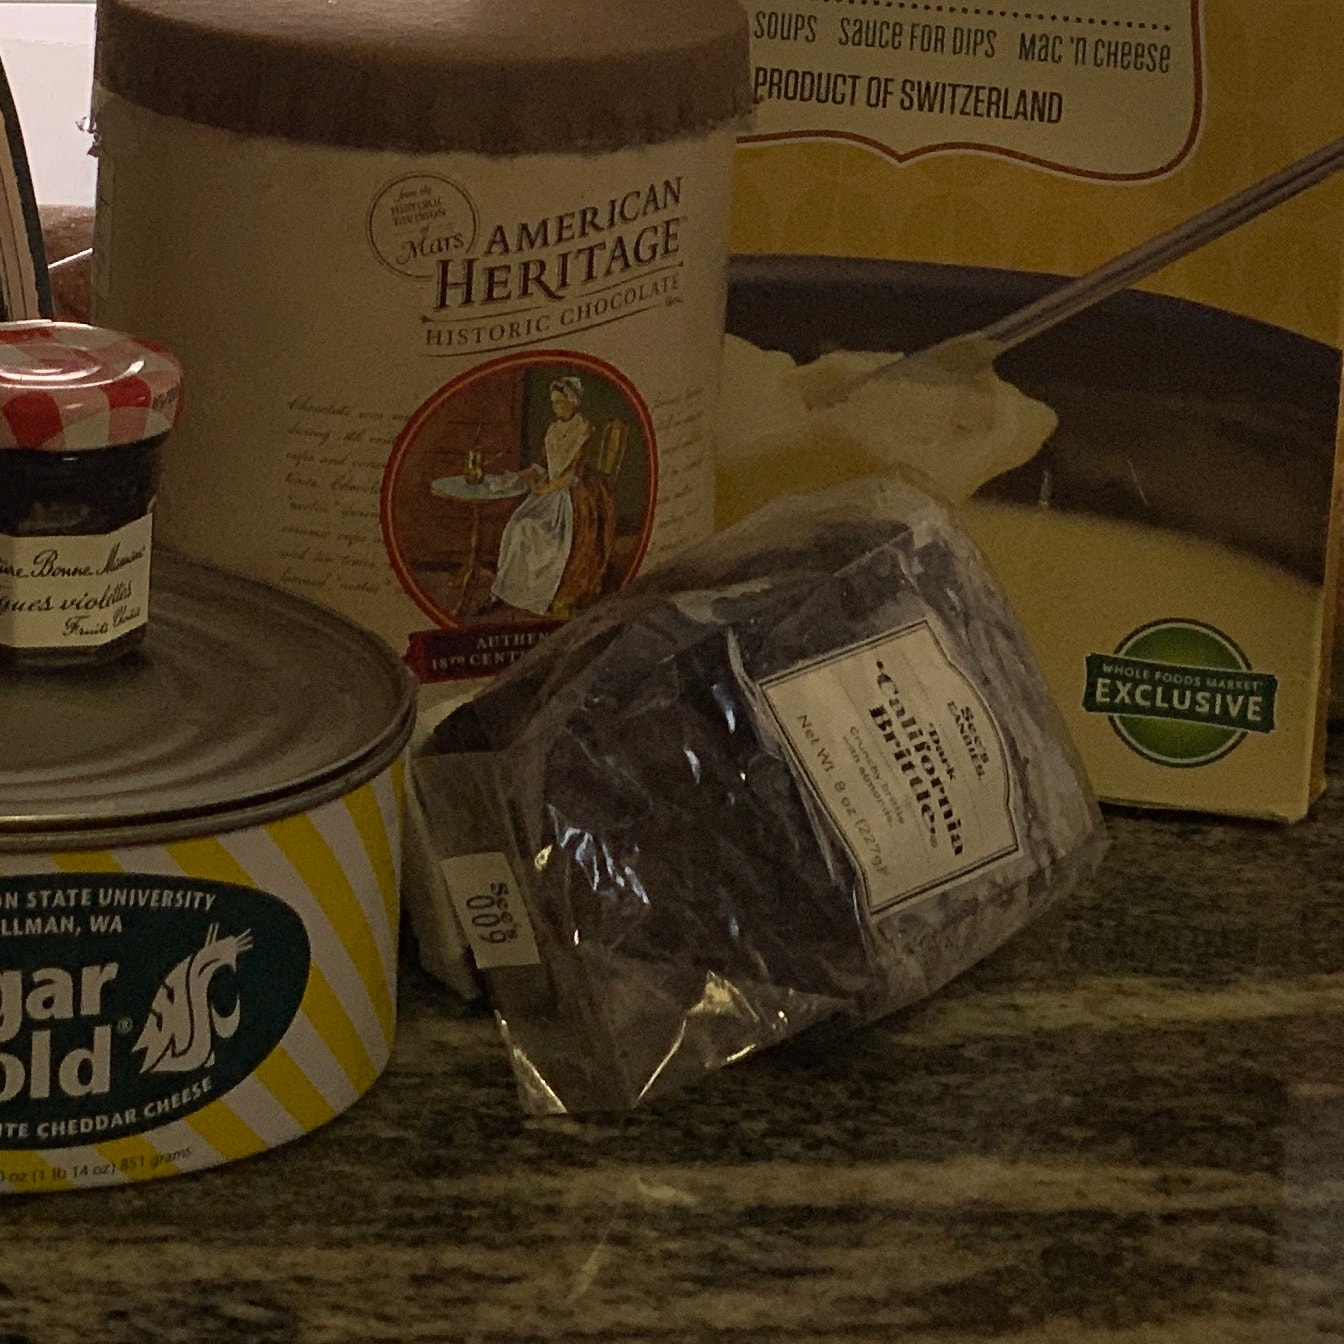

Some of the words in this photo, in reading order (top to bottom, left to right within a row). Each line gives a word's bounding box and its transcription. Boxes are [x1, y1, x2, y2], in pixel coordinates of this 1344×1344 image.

[753, 10, 818, 43] SOUPS
[909, 22, 946, 55] FOR
[952, 25, 997, 58] DIPS
[753, 67, 860, 106] PRODUCT
[867, 76, 895, 109] OF
[900, 79, 1063, 124] SWITZERLAND
[484, 175, 684, 257] AMERICAN
[395, 232, 464, 265] Mars
[433, 217, 682, 313] HERITAGE
[426, 313, 551, 347] HISTORIC
[560, 275, 680, 324] CHOCOLATE
[31, 549, 92, 577] Bonne
[1095, 677, 1262, 722] EXCLUSIVE
[1102, 663, 1150, 681] WHOLE
[1154, 670, 1201, 688] FOODS
[1206, 677, 1259, 692] MARKET
[797, 714, 819, 746] Net
[834, 781, 846, 793] 8
[869, 705, 935, 822] Brittle
[877, 672, 963, 856] California
[28, 887, 92, 910] STATE
[98, 886, 217, 913] UNIVERSITY
[89, 914, 124, 935] WA
[37, 1108, 138, 1140] CHEDDAR
[143, 1076, 213, 1122] CHEESE
[32, 1168, 46, 1184] (1
[72, 1164, 88, 1178] 14
[93, 1161, 116, 1176] oz)
[120, 1155, 145, 1172] 851
[148, 1146, 194, 1169] grams
